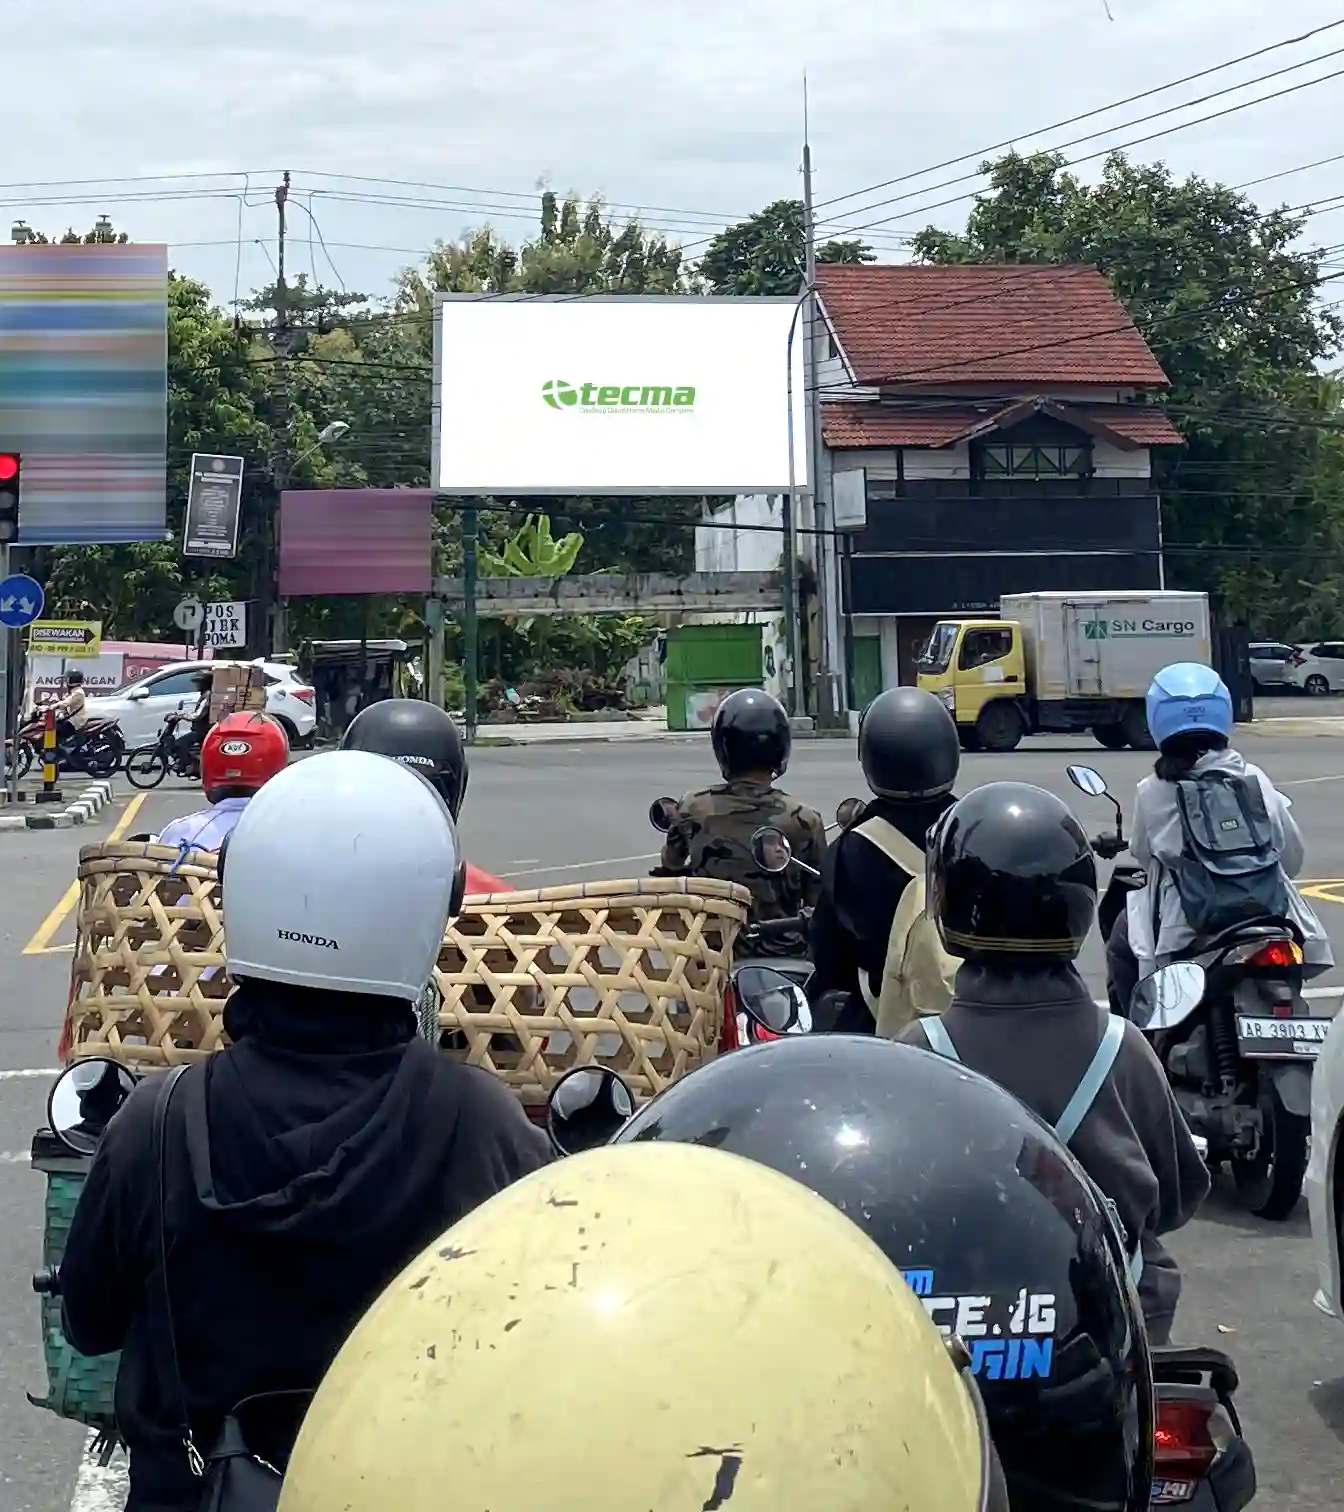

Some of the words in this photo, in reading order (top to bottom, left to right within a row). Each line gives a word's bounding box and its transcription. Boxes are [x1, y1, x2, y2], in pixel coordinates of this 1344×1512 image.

[579, 382, 696, 406] tecma
[205, 619, 240, 632] JEK
[1112, 620, 1136, 632] SN
[1142, 619, 1195, 634] Cargo
[276, 928, 341, 950] HONDA
